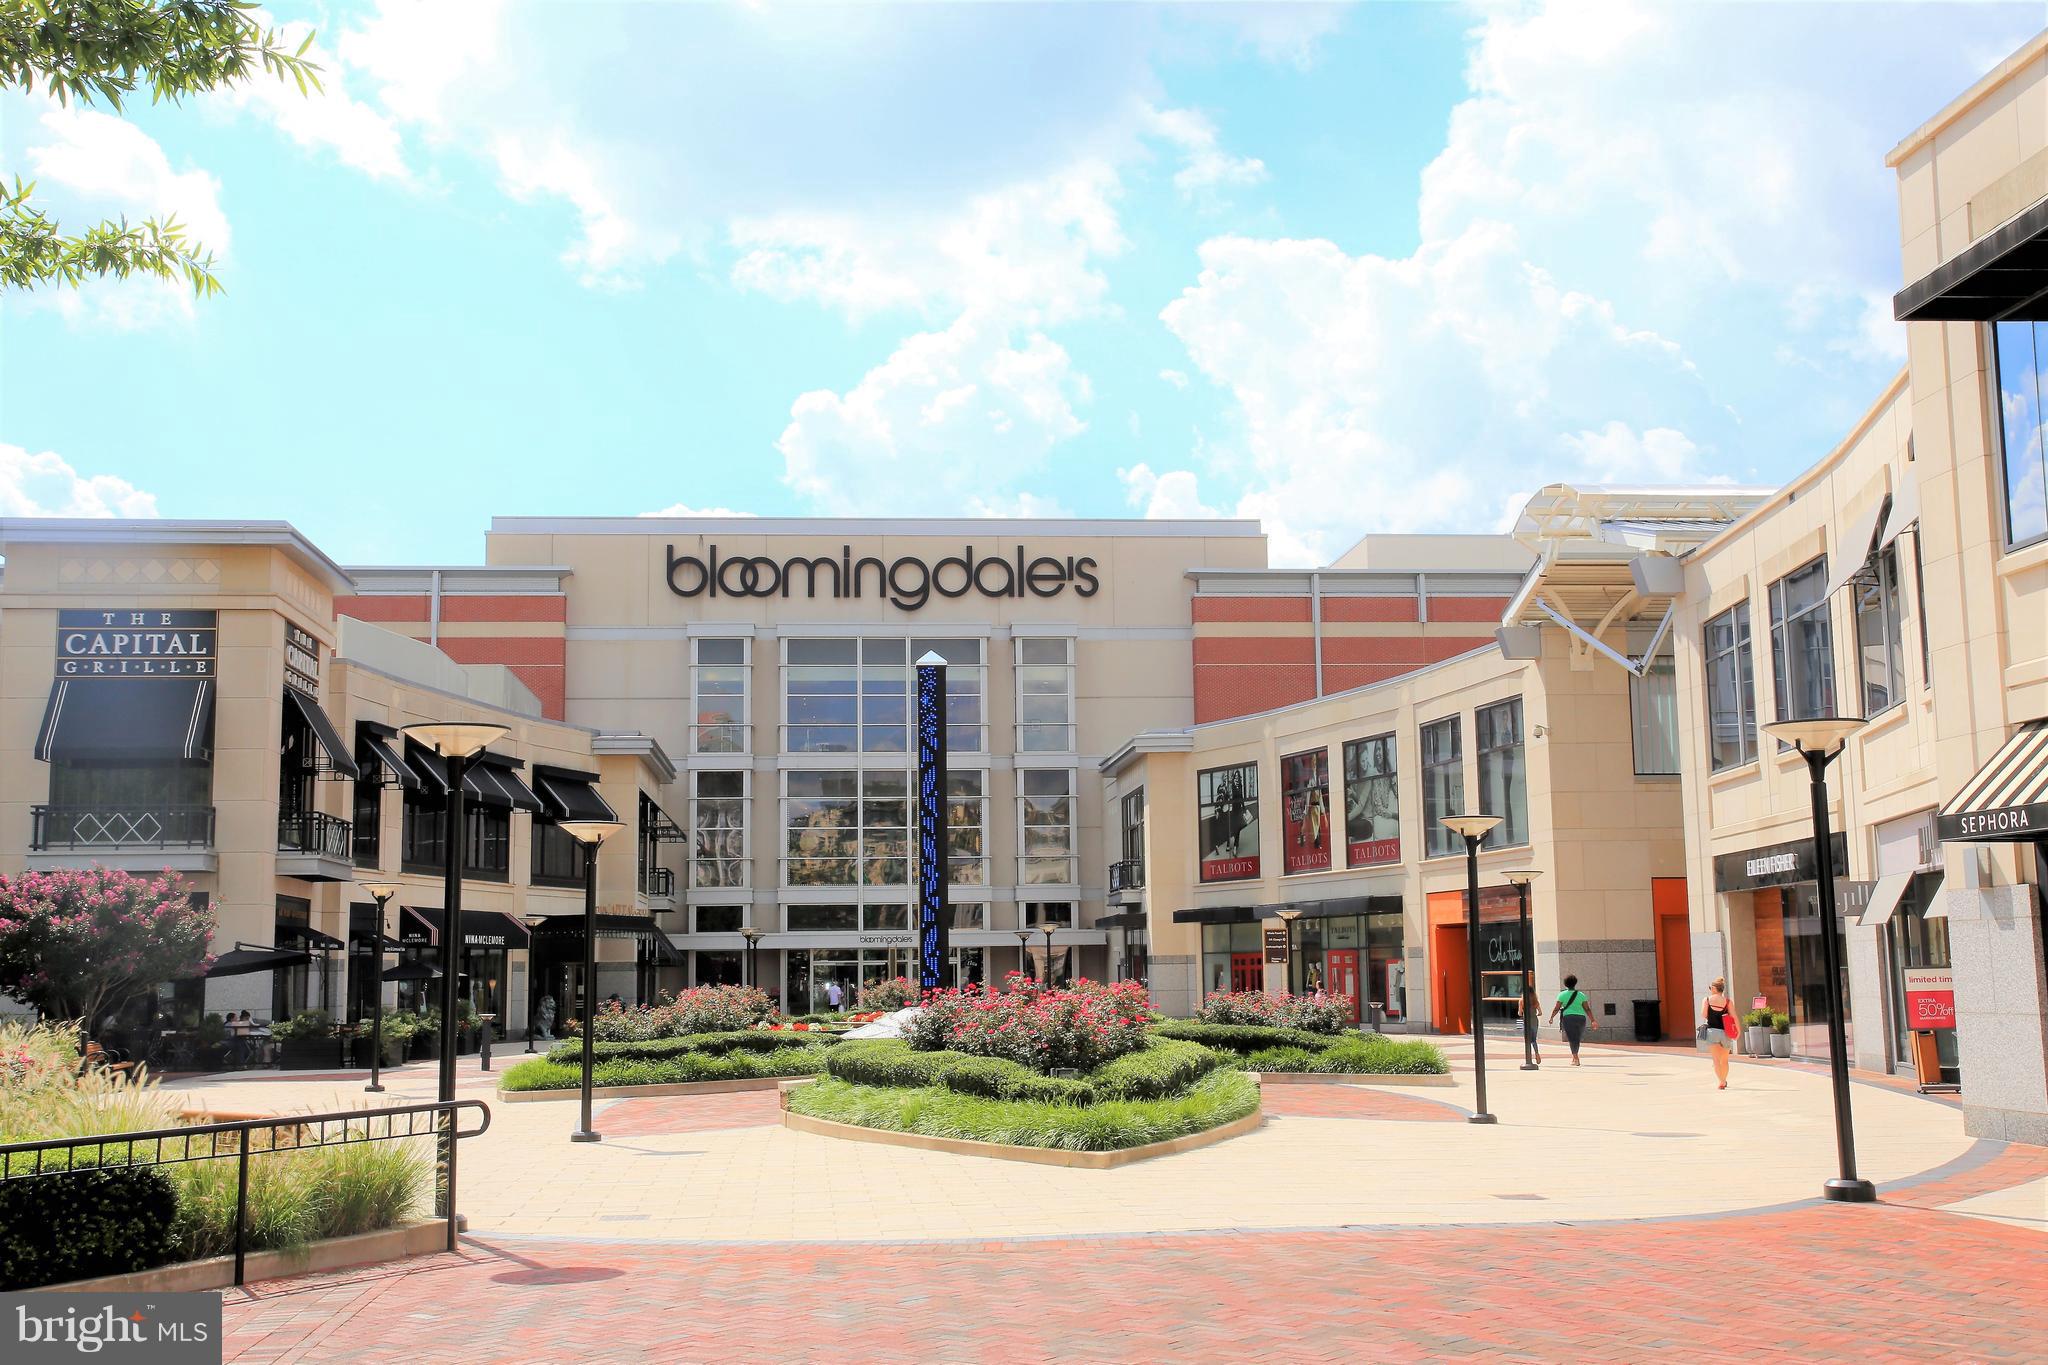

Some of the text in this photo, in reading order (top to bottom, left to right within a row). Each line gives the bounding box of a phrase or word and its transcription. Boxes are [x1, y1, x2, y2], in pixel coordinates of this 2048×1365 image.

[666, 544, 1099, 612] bloomingdale's
[103, 613, 172, 625] THE
[65, 633, 207, 655] CAPITAL
[1961, 810, 2029, 834] SEPHORA
[1290, 852, 1329, 867] TALBOTS
[1354, 844, 1397, 859] TALBOTS
[1210, 861, 1253, 875] TALBOTS
[1489, 936, 1507, 962] Cole
